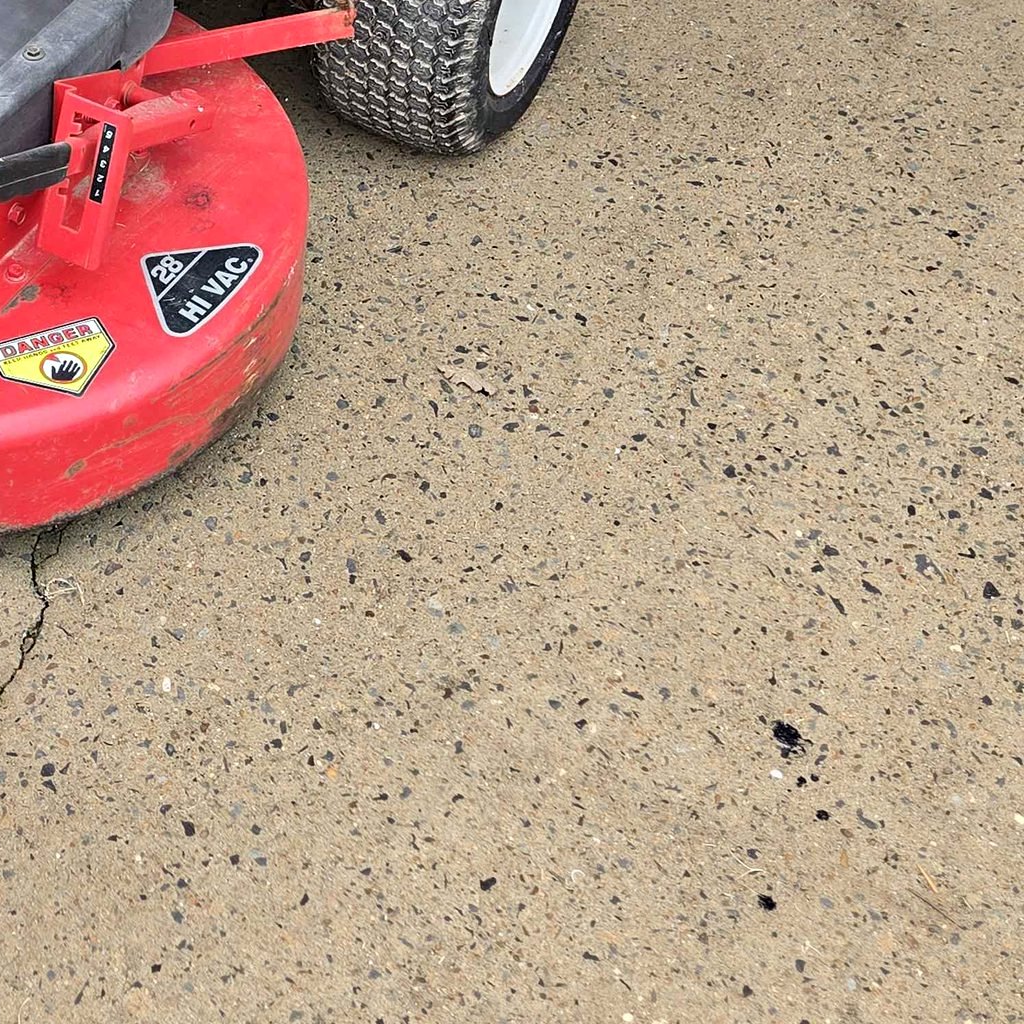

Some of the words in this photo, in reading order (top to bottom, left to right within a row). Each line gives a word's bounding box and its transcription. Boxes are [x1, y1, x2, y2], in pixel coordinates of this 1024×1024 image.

[150, 255, 184, 285] 28
[178, 295, 213, 323] HI
[0, 324, 93, 359] DANGER
